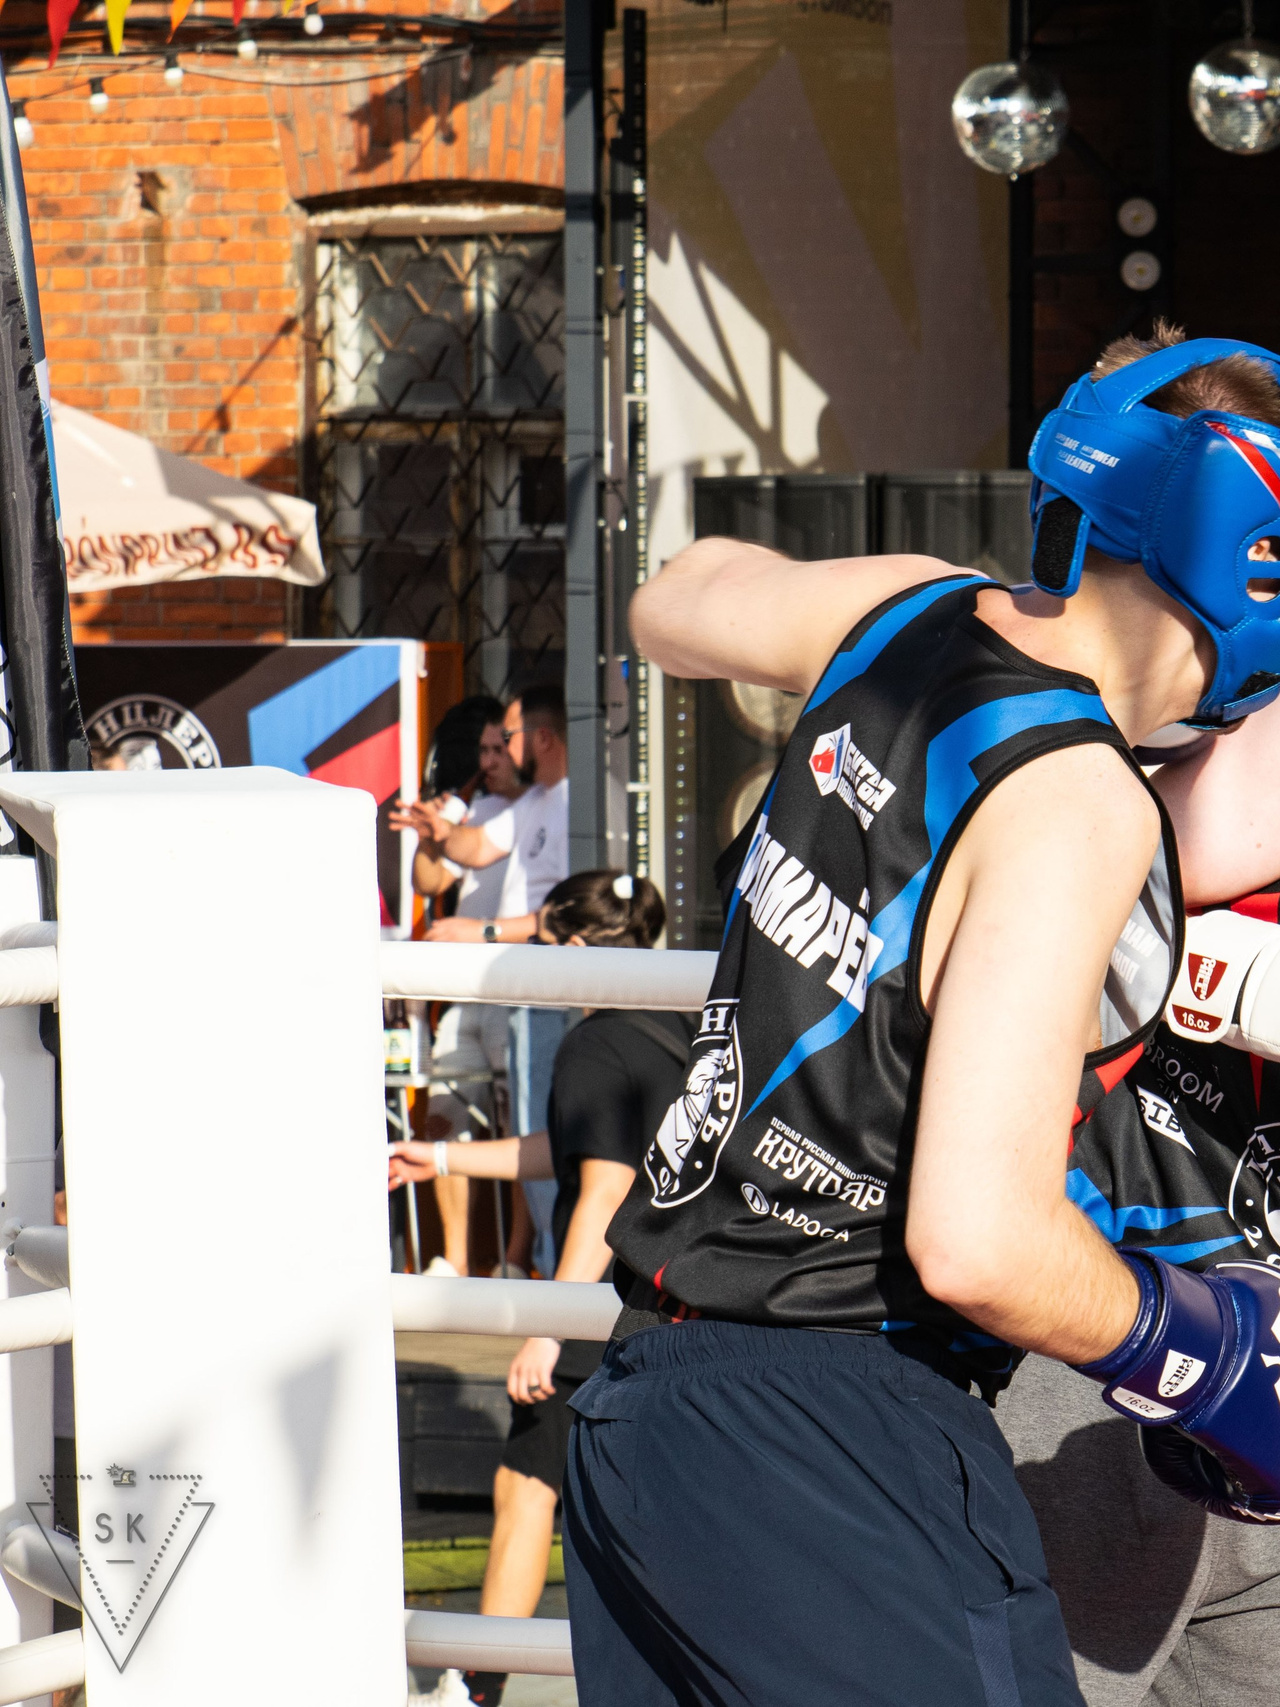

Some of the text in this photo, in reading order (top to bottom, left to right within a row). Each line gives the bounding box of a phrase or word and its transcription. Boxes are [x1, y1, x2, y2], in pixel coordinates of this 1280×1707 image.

[1065, 454, 1096, 475] LEATHER
[1090, 449, 1120, 468] SWEAT
[94, 702, 213, 769] НЦЛЕР
[753, 1128, 886, 1211] КРУТОЯР
[771, 1116, 888, 1188] ПЕРВАЯ РУССКАЯ ВИНОКУРНЯ
[771, 1202, 849, 1242] LADOGA
